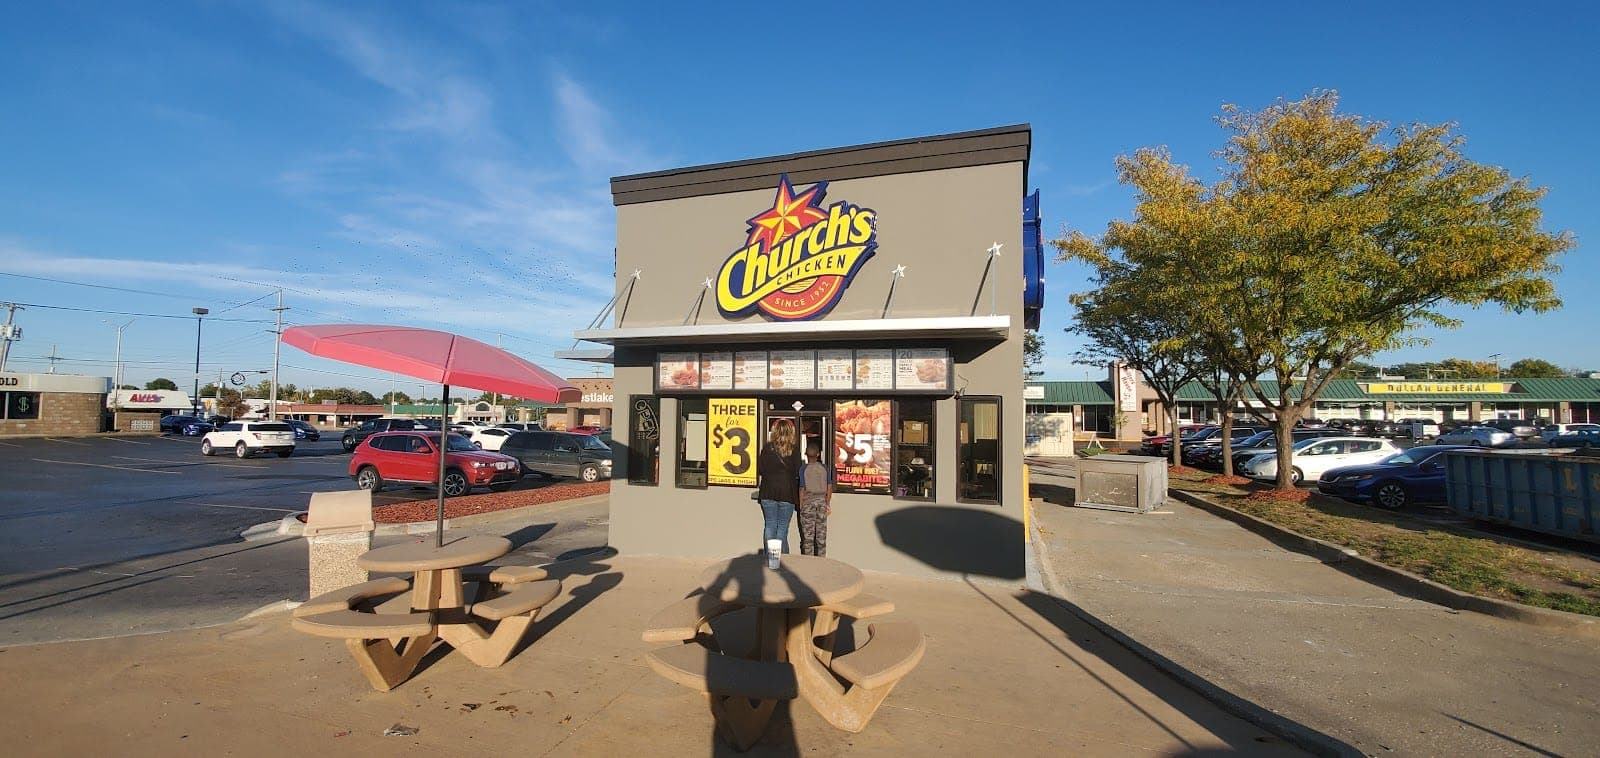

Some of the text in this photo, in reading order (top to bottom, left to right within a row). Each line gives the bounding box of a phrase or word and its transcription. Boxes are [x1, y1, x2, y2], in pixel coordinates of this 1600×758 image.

[717, 205, 873, 312] Church's
[776, 254, 846, 286] CHICKEN
[774, 281, 830, 307] SINCE 1952
[129, 393, 161, 403] AVIS
[1387, 384, 1487, 392] DOLLAR GENERAL
[635, 400, 659, 440] OPEN
[712, 404, 756, 416] THREE
[725, 416, 740, 427] for
[712, 424, 751, 475] $3
[845, 431, 873, 463] $5
[836, 473, 889, 484] MEGABITES
